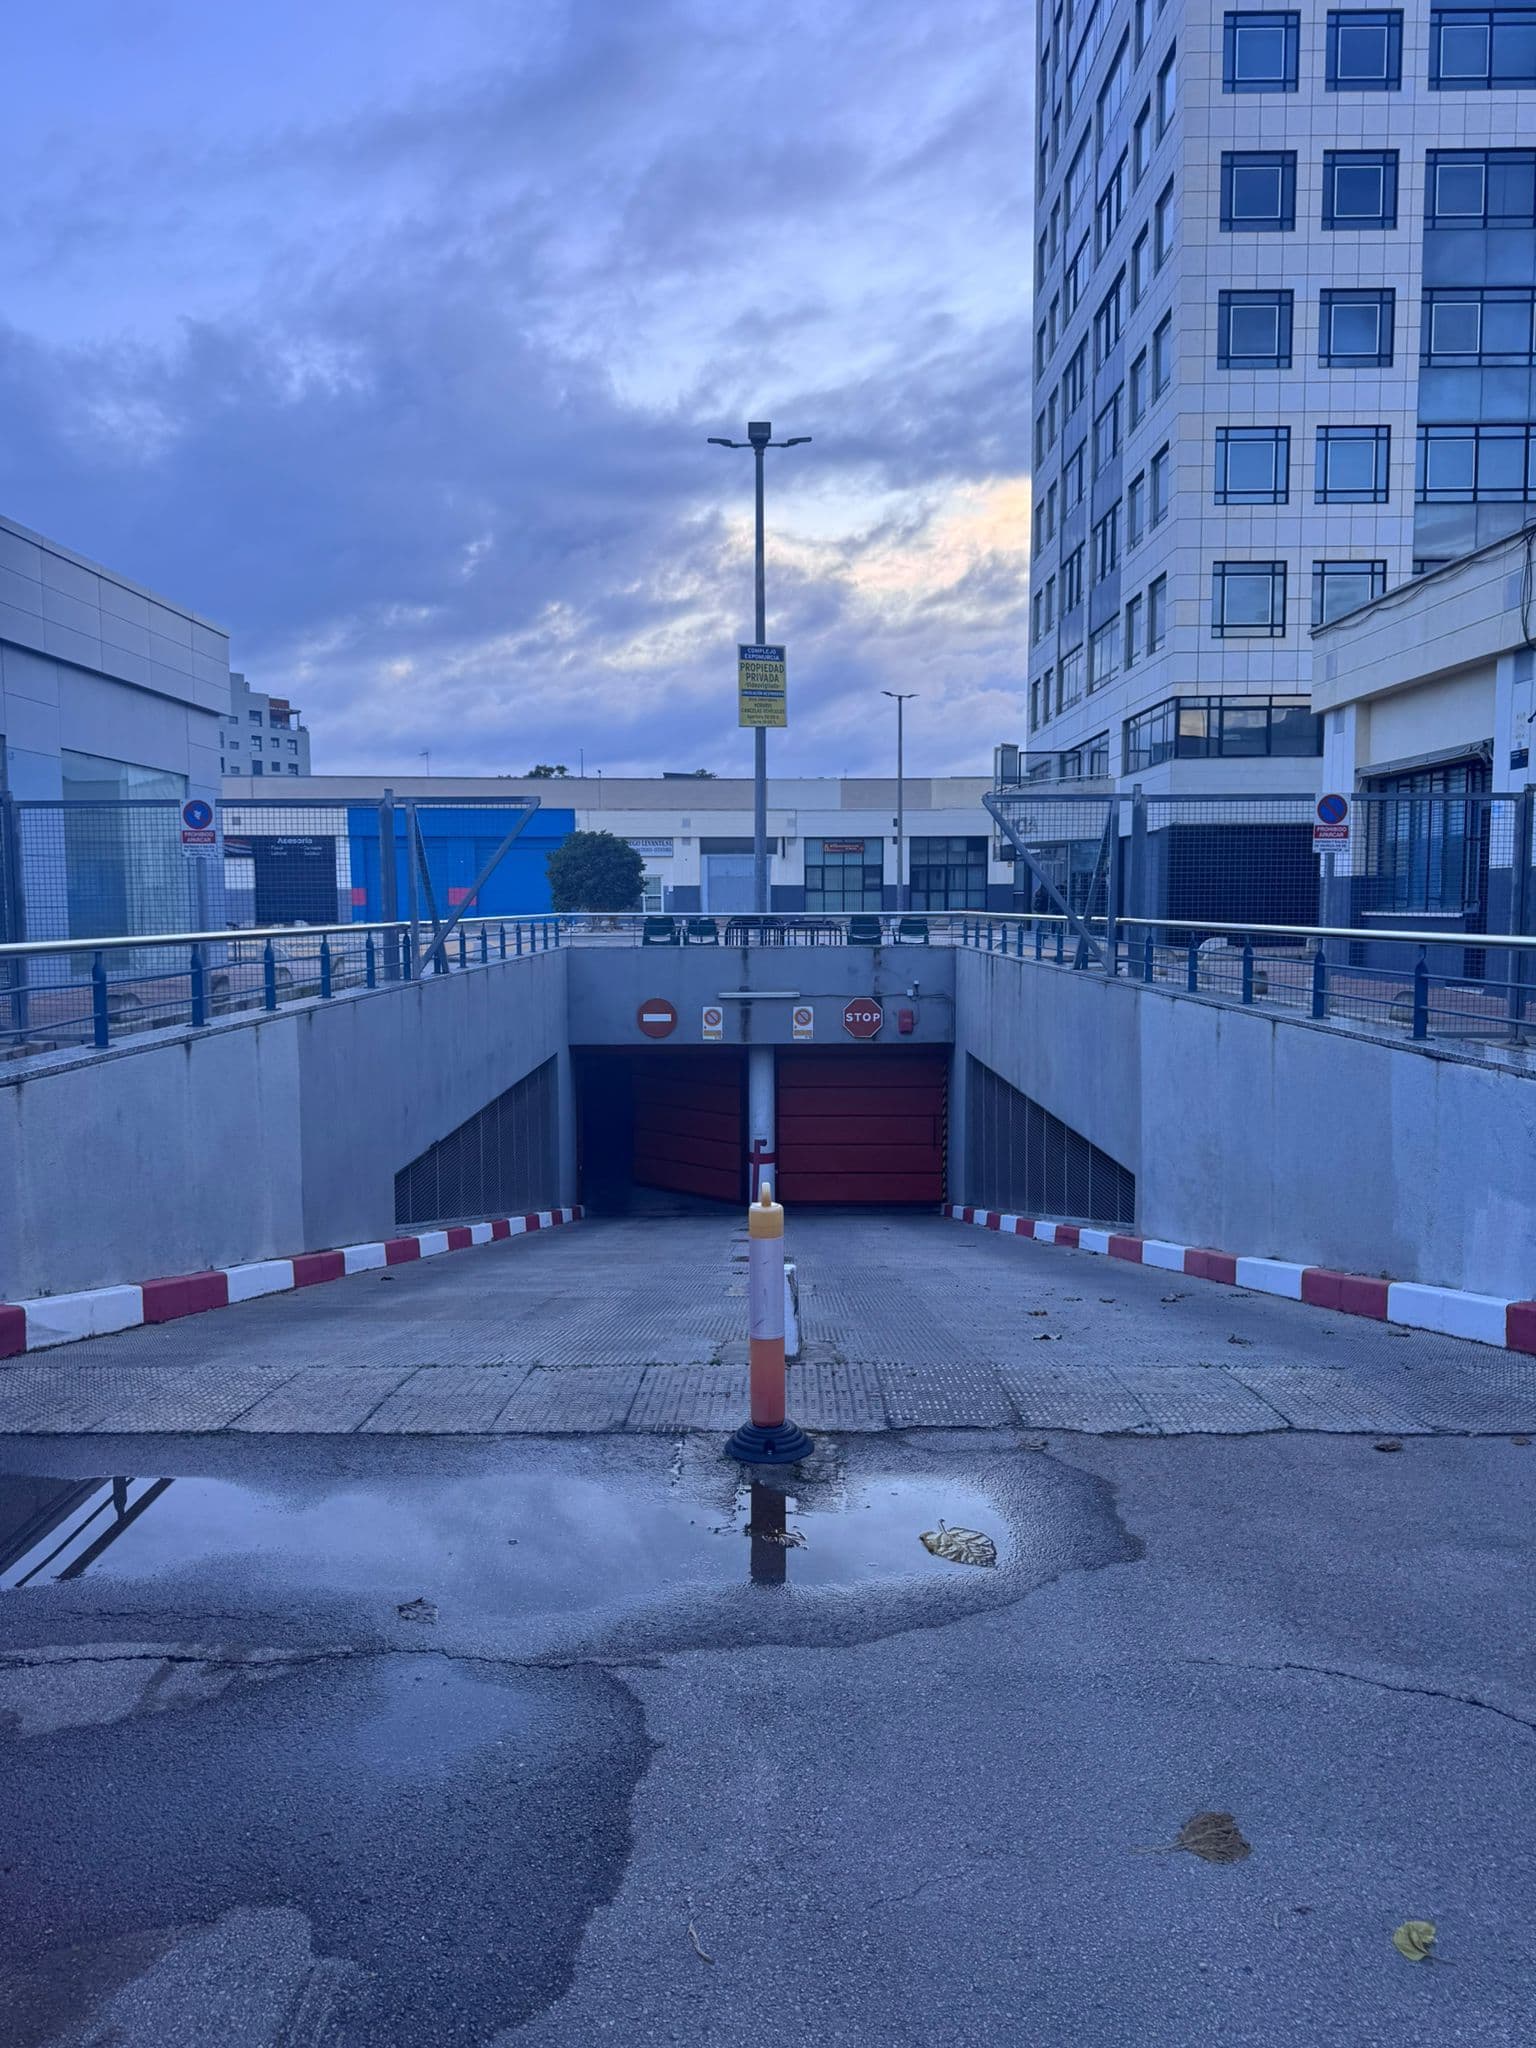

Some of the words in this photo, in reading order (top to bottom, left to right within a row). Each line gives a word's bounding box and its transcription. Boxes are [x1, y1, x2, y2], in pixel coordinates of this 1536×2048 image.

[740, 663, 784, 673] PROPIEDAD
[746, 672, 780, 682] PRIVADA
[845, 1012, 881, 1022] STOP
